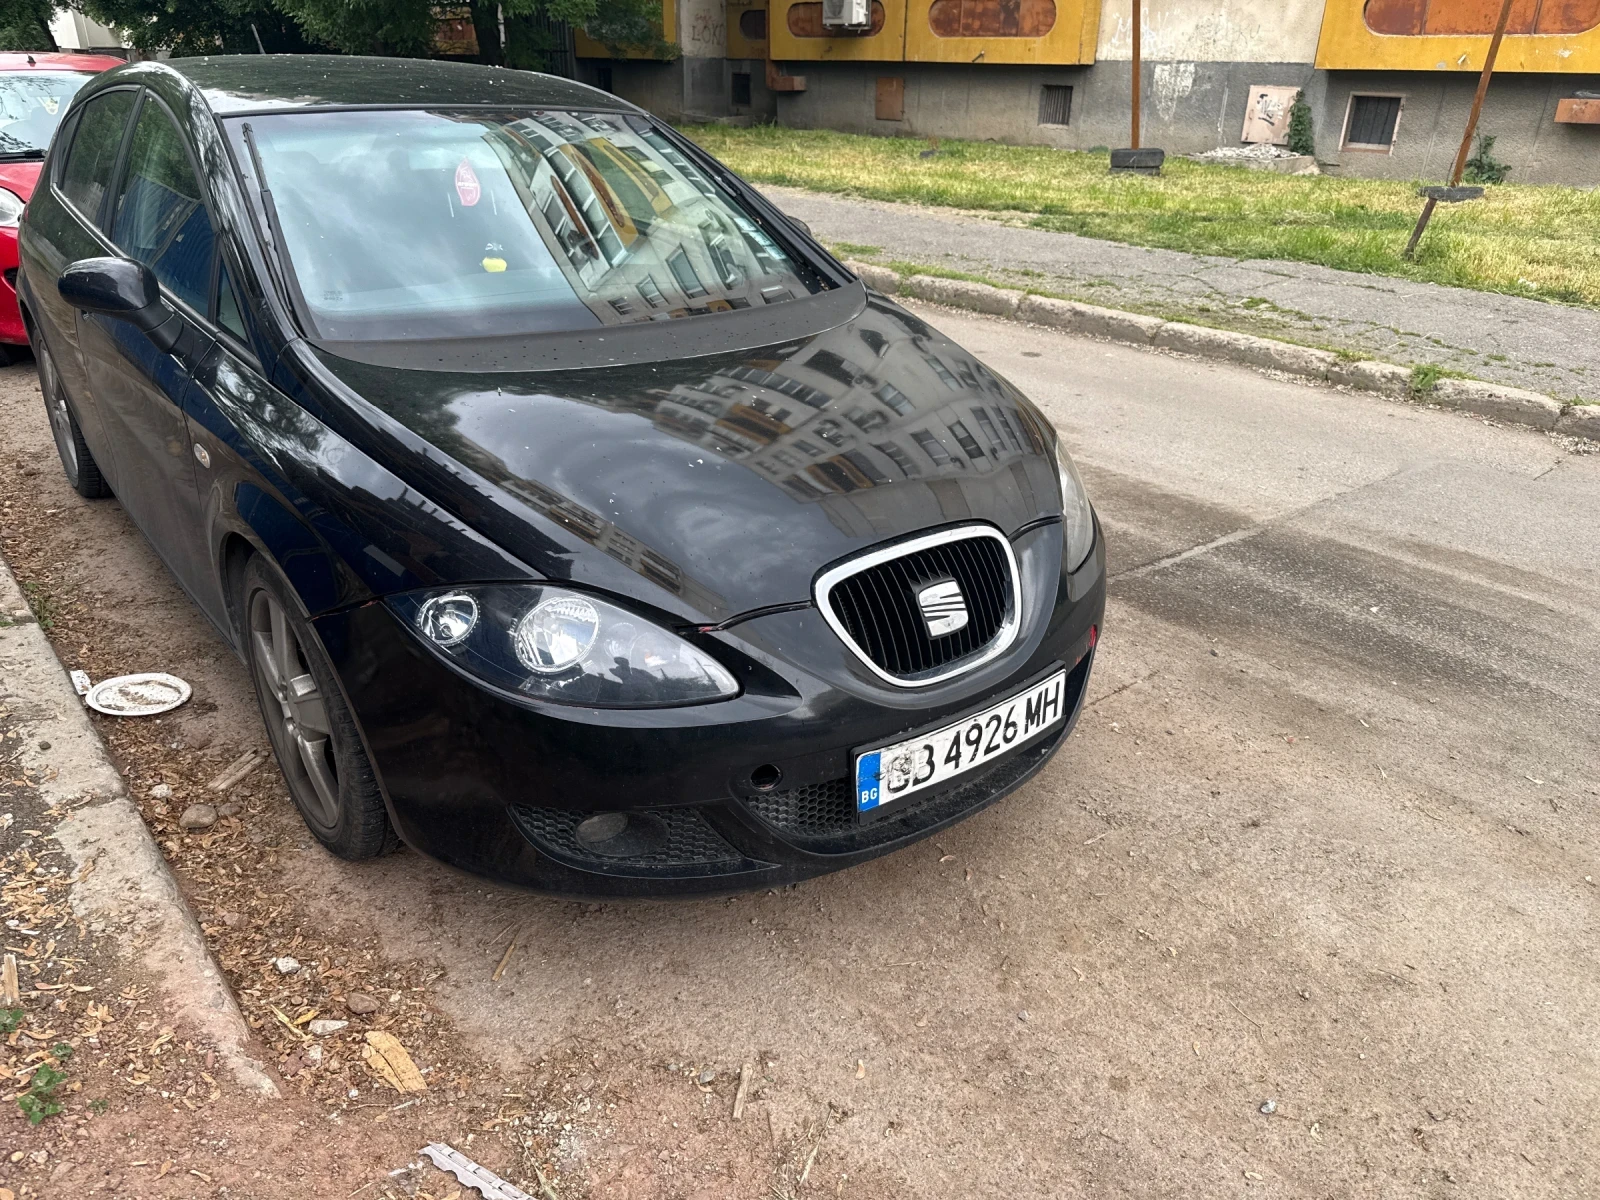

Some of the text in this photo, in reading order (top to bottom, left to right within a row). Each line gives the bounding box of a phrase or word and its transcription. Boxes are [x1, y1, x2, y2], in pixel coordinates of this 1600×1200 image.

[944, 704, 1018, 770] 4926
[1024, 681, 1060, 734] MH
[861, 788, 878, 804] BG
